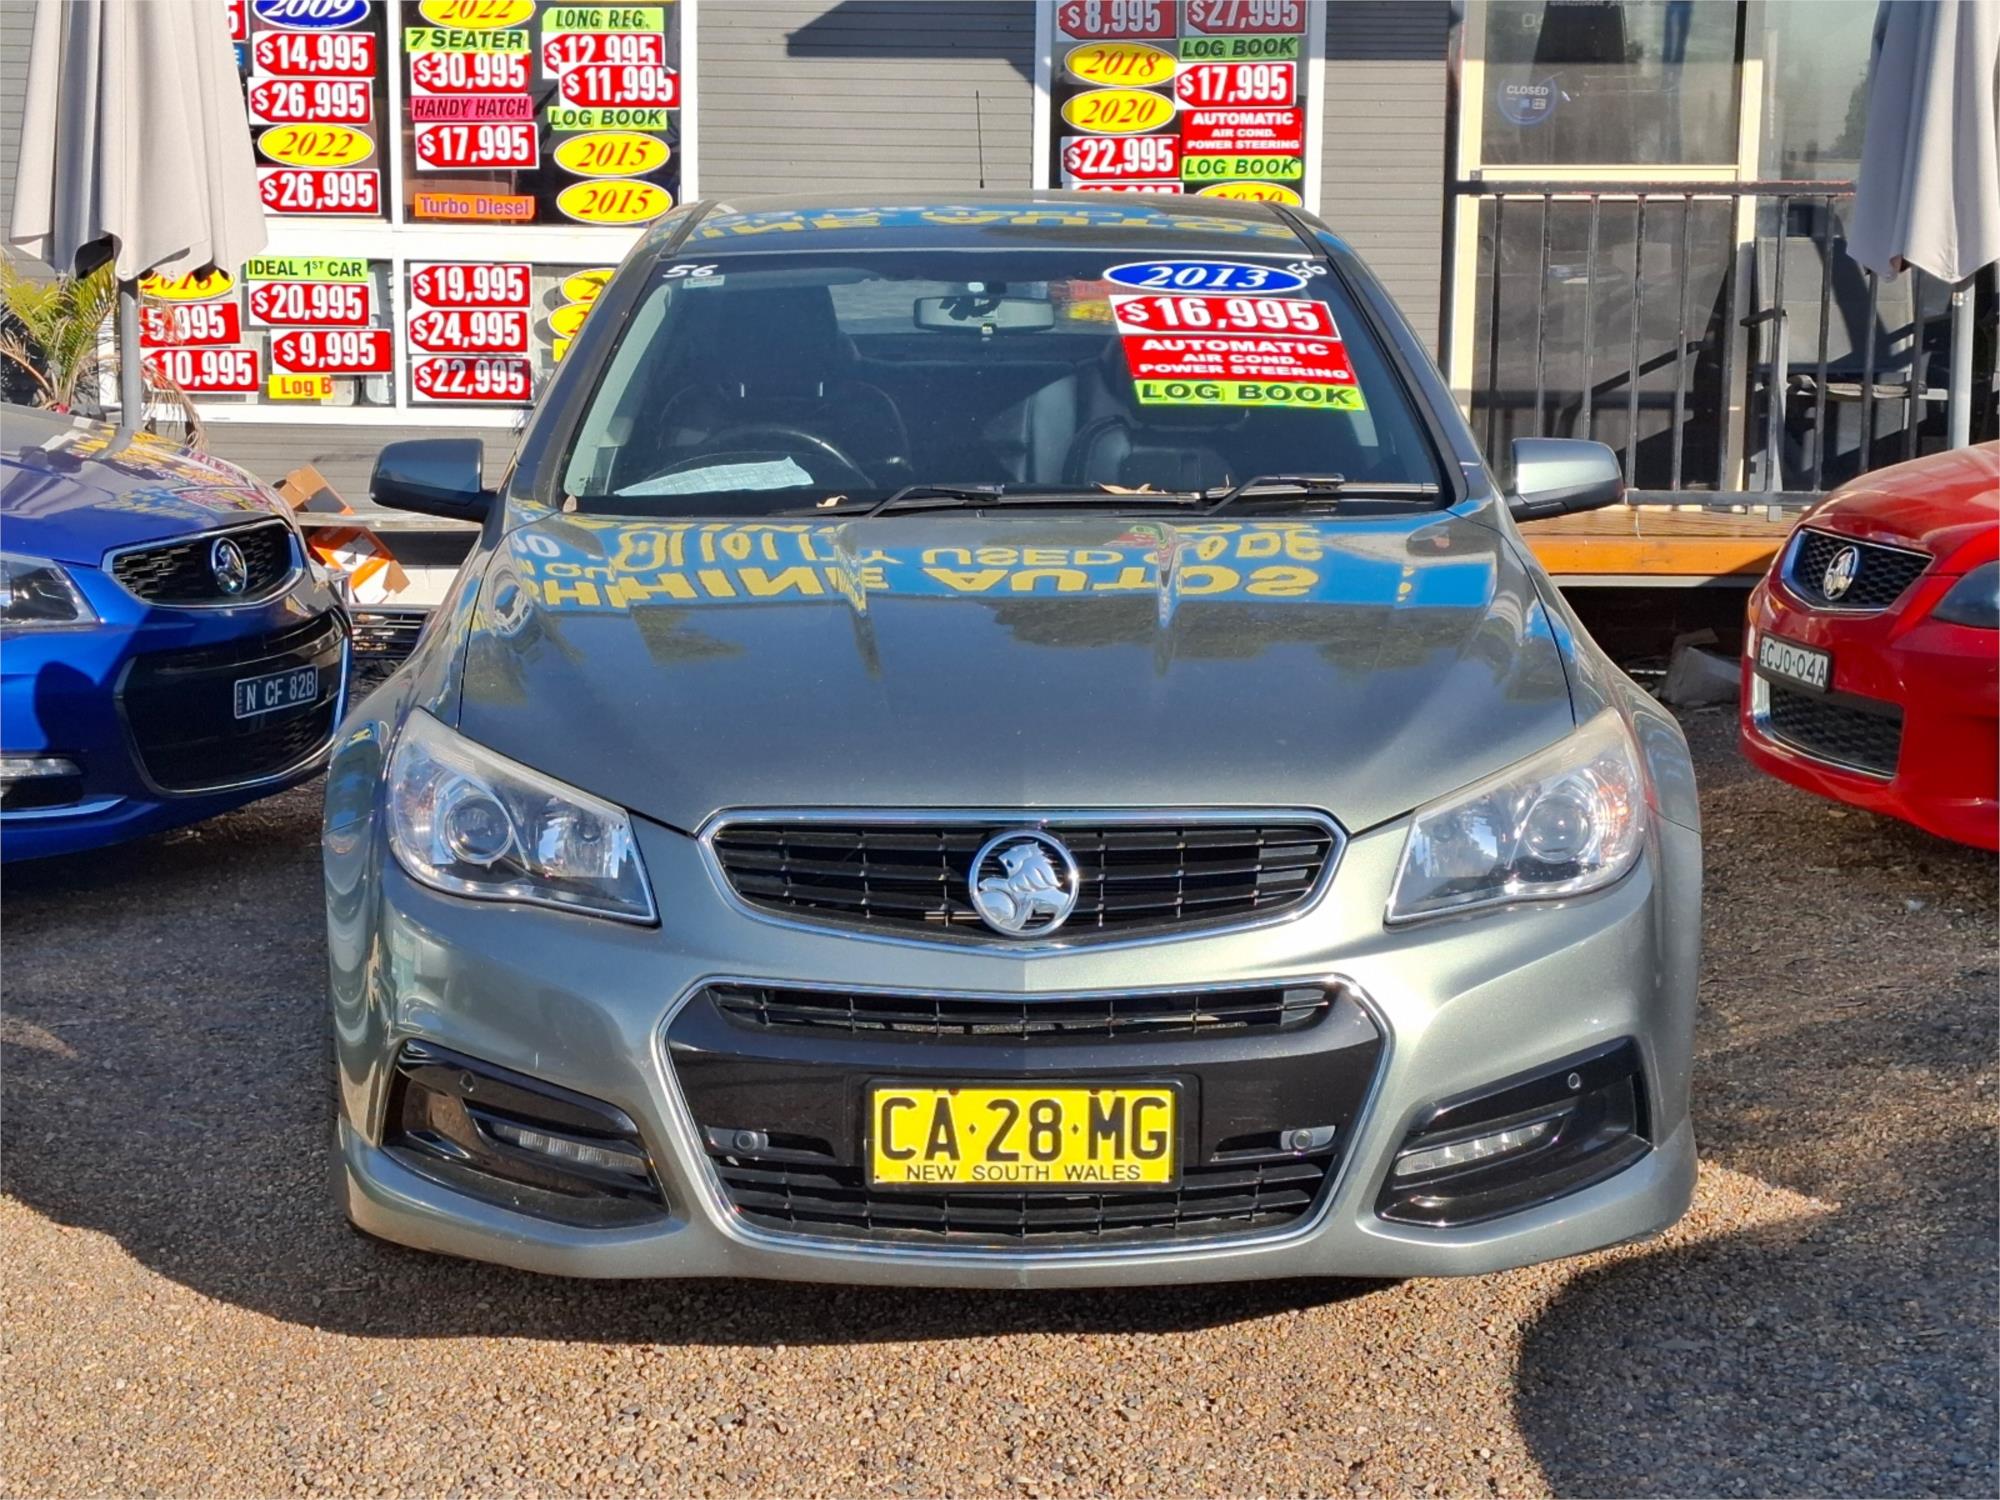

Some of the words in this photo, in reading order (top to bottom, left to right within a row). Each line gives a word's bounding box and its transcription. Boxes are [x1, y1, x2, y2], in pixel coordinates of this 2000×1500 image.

[440, 0, 514, 19] 2022
[556, 10, 600, 27] LONG
[609, 10, 649, 28] REG.
[1068, 0, 1160, 34] $8,995
[1192, 0, 1298, 28] $27,995
[411, 30, 426, 46] 7
[431, 31, 522, 48] SEATER
[545, 35, 655, 65] $12995
[1182, 41, 1225, 57] LOG
[1233, 38, 1296, 55] BOOK
[260, 35, 368, 72] $14,995
[1085, 50, 1160, 76] 2018
[416, 53, 526, 89] $30,995
[564, 66, 673, 102] $11,995
[1180, 64, 1287, 103] $17,995
[1506, 85, 1549, 96] CLOSED
[255, 82, 365, 119] $26,995
[414, 98, 470, 117] HANDY
[475, 98, 527, 116] HATCH
[1080, 98, 1157, 124] 2020
[550, 110, 596, 127] LOG
[602, 109, 664, 126] BOOK
[1192, 113, 1294, 124] AUTOMATIC
[279, 133, 353, 156] 2022
[420, 125, 529, 164] $17,995
[1187, 140, 1233, 149] POWER
[1236, 140, 1299, 149] STEERING
[1212, 129, 1234, 137] AIR
[1237, 128, 1276, 137] COND.
[578, 140, 647, 167] 2015
[1067, 138, 1173, 175] $22,995
[1185, 159, 1226, 175] LOG
[1235, 159, 1297, 174] BOOK
[263, 172, 373, 207] $26,995
[579, 188, 649, 215] 2015
[421, 196, 472, 215] Turbo
[476, 198, 529, 216] Diesel
[248, 260, 299, 278] IDEAL
[303, 260, 324, 278] 1ST
[328, 261, 362, 278] CAR
[662, 265, 719, 278] 56
[1140, 267, 1269, 288] 2013
[417, 265, 525, 303] $19,995
[255, 284, 362, 321] $20,995
[1122, 298, 1320, 331] $16,995
[415, 311, 521, 349] $24,995
[283, 333, 376, 369] $9,995
[1142, 340, 1329, 356] AUTOMATIC
[1183, 354, 1224, 362] AIR
[1230, 354, 1302, 365] COND.
[417, 358, 525, 397] $22,995
[1139, 364, 1224, 374] POWER
[1231, 365, 1349, 379] STEERING
[281, 377, 314, 396] Log
[1142, 384, 1222, 400] LOG
[1238, 386, 1352, 404] BOOK
[246, 684, 256, 711] N
[265, 679, 283, 706] CF
[289, 671, 314, 700] 82B
[907, 1165, 956, 1180] NEW
[973, 1165, 1049, 1181] SOUTH
[1065, 1165, 1140, 1180] WALES
